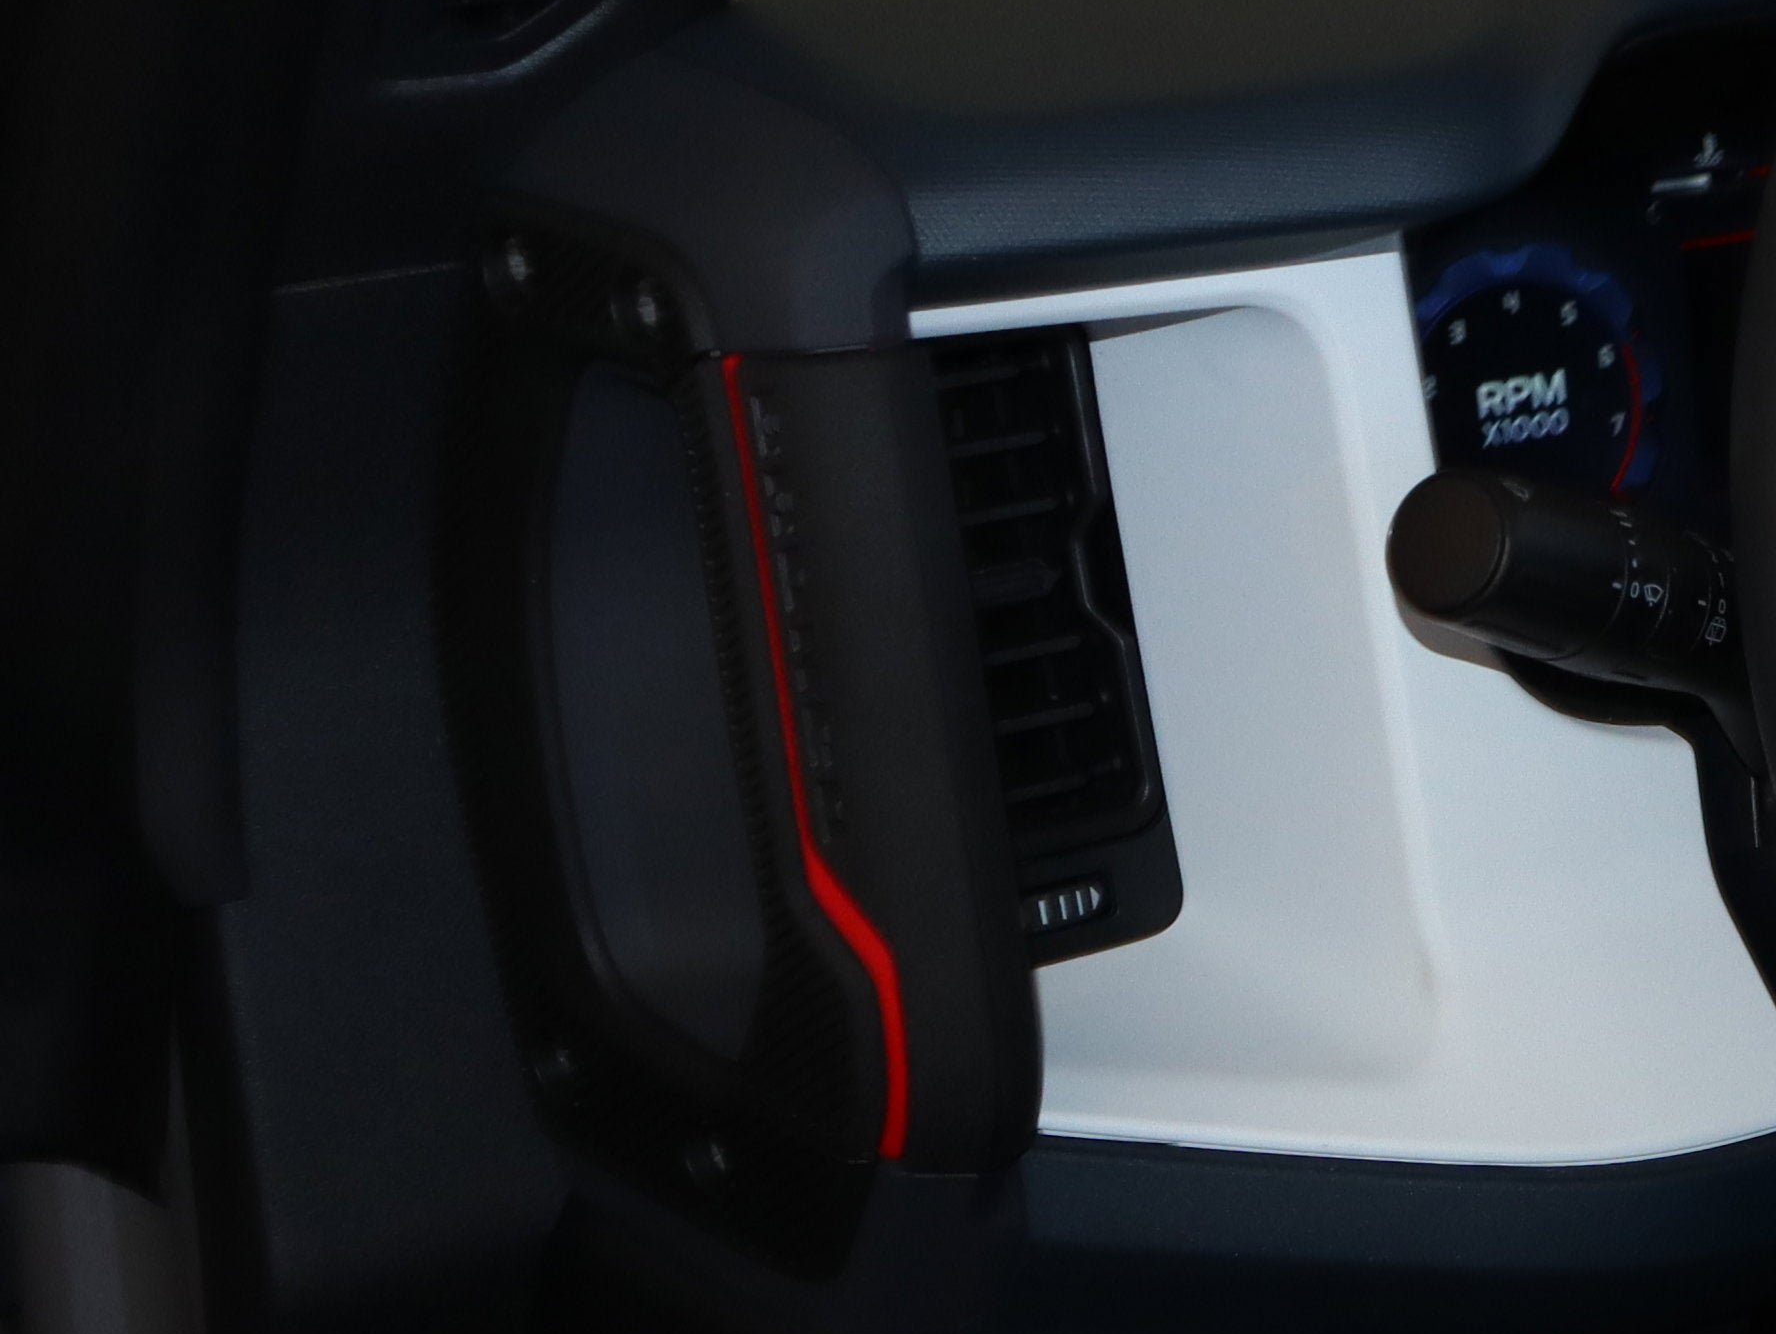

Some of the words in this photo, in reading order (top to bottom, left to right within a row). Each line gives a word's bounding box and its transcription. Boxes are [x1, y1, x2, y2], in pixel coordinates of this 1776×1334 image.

[1560, 299, 1579, 327] 5
[1447, 317, 1468, 347] 3
[1596, 342, 1616, 370] 6
[1475, 367, 1568, 420] RPM
[1480, 406, 1571, 450] X1000
[1609, 411, 1627, 438] 7
